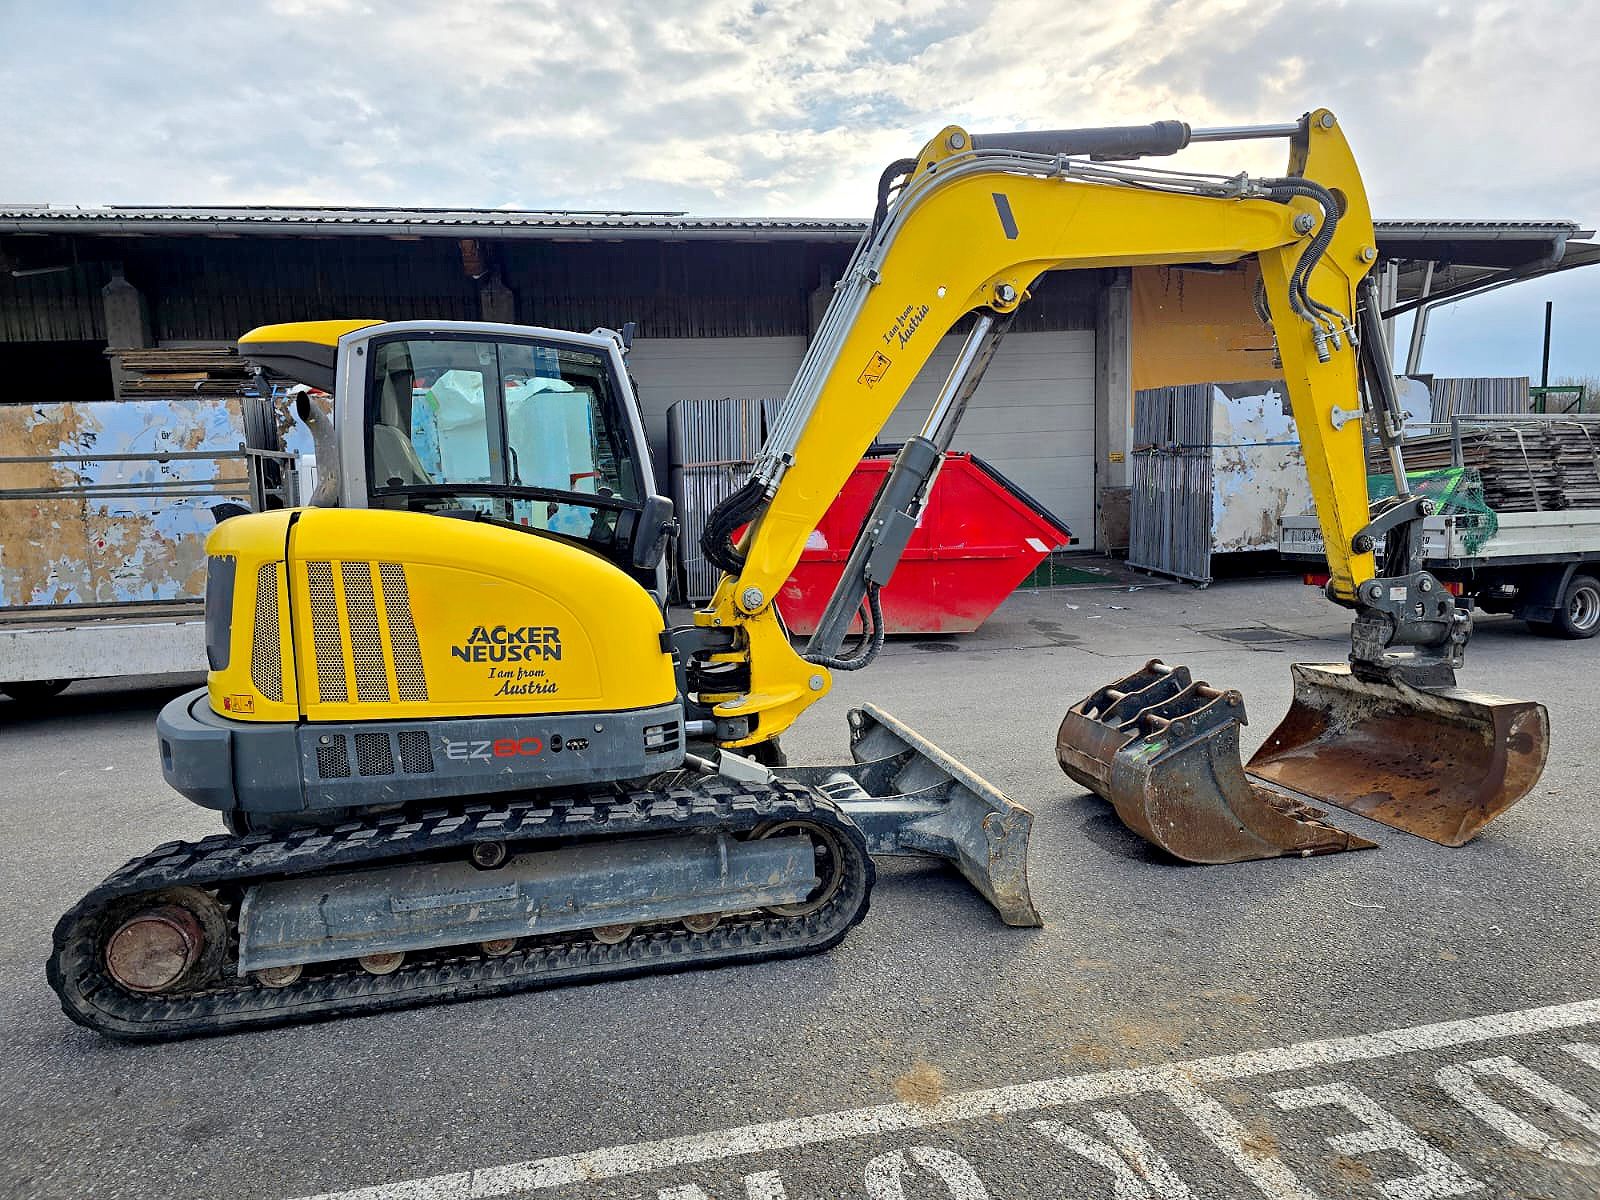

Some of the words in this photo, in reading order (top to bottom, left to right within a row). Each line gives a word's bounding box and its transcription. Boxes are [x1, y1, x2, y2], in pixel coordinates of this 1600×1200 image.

[883, 335, 890, 344] I
[889, 325, 899, 337] am
[896, 305, 913, 327] from
[898, 305, 929, 350] Austria
[451, 644, 562, 662] NEUSON
[488, 668, 496, 679] I
[497, 669, 515, 678] am
[516, 667, 546, 680] from
[494, 679, 559, 697] Austria
[447, 737, 543, 759] EZ80
